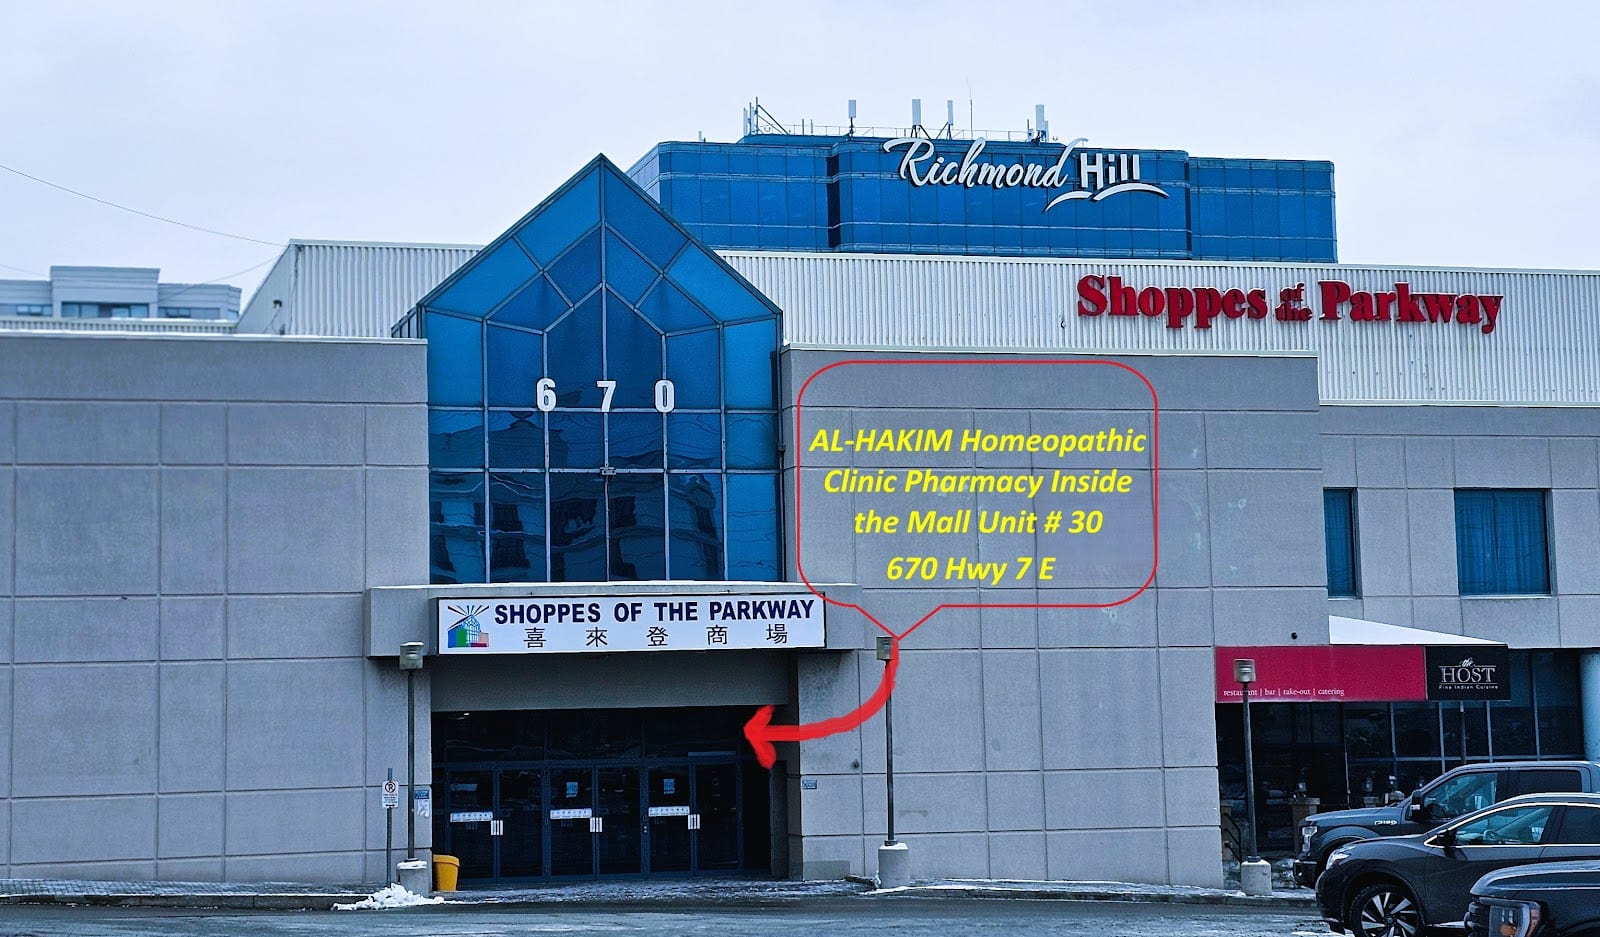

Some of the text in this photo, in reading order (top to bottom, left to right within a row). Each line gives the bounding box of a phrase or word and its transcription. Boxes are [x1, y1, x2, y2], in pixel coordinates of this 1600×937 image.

[883, 137, 1140, 190] Richmond Hill
[1077, 274, 1504, 334] Shoppes of the Parkway
[494, 599, 814, 624] SHOPPES OF THE PARKWAY
[523, 623, 789, 649] 喜來登商場
[1441, 667, 1495, 683] HOST
[1264, 688, 1276, 696] bar
[1283, 688, 1311, 696] take-out
[1317, 688, 1345, 697] catering
